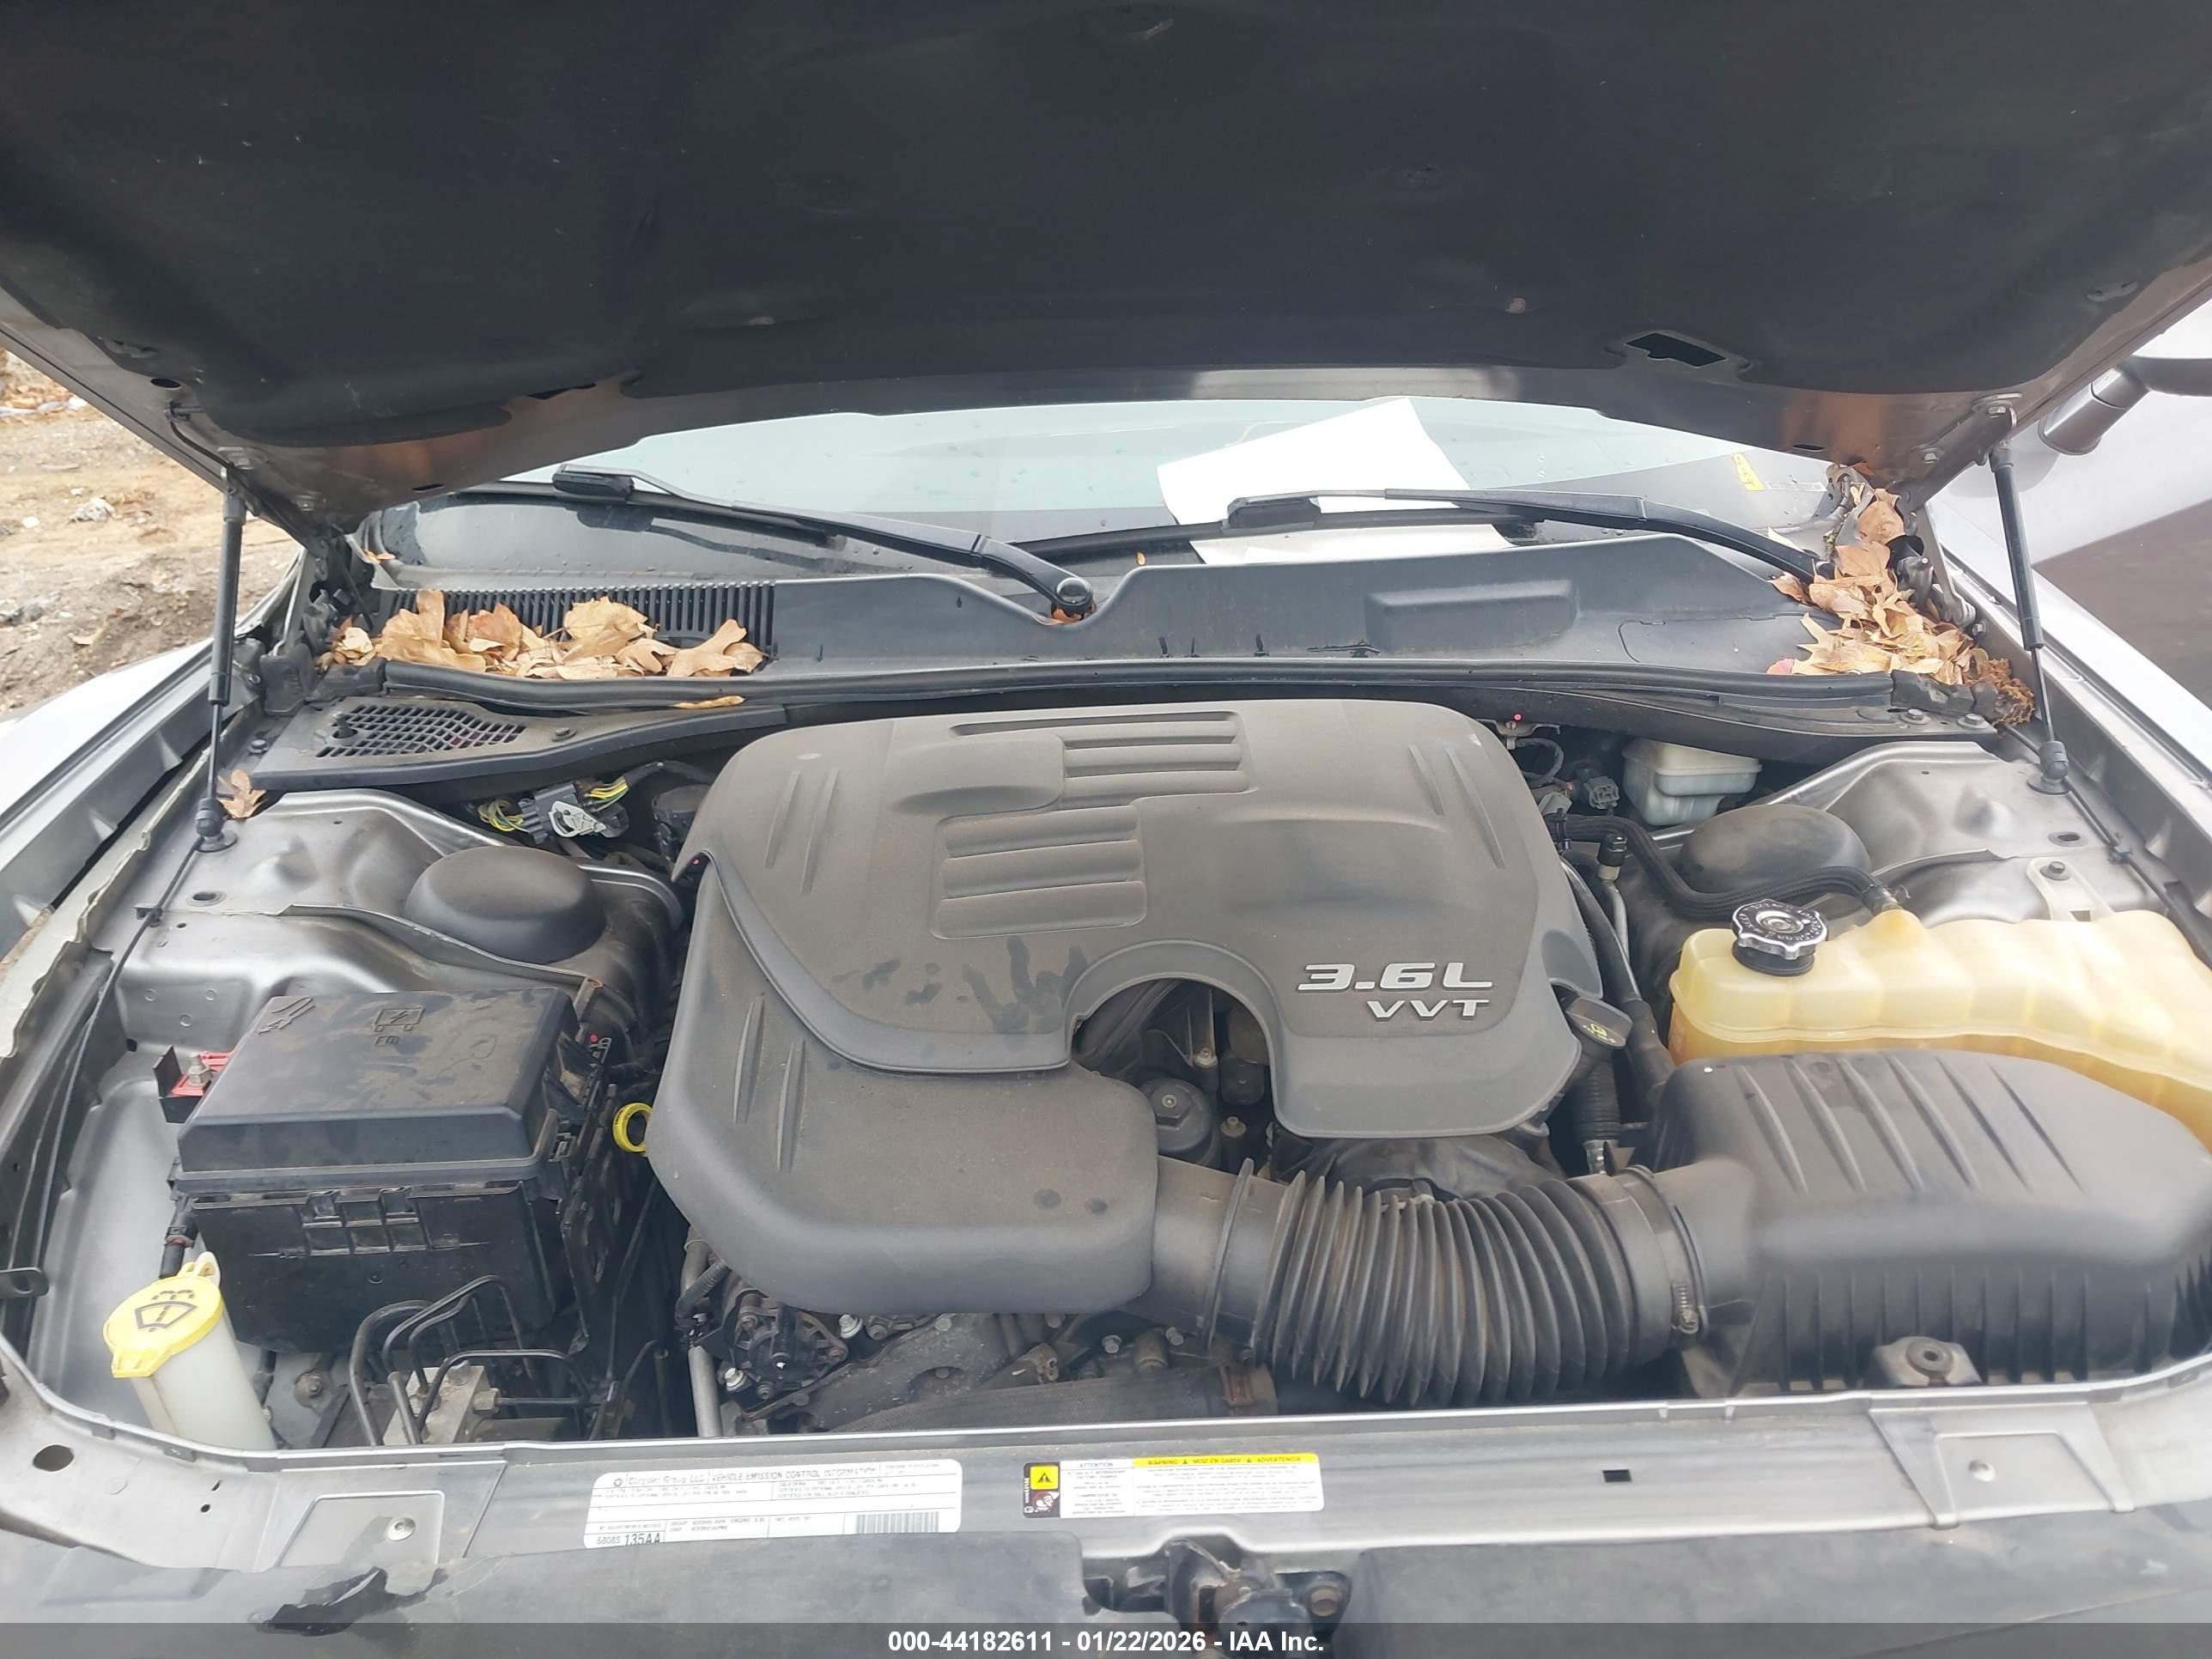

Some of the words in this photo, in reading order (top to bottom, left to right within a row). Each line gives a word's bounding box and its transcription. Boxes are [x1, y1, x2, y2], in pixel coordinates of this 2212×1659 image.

[1297, 962, 1492, 991] 3.6L
[1366, 999, 1491, 1020] VVT
[713, 1473, 743, 1481] VEHICLE
[746, 1471, 782, 1480] EMISSION
[785, 1469, 820, 1479] CONTROL
